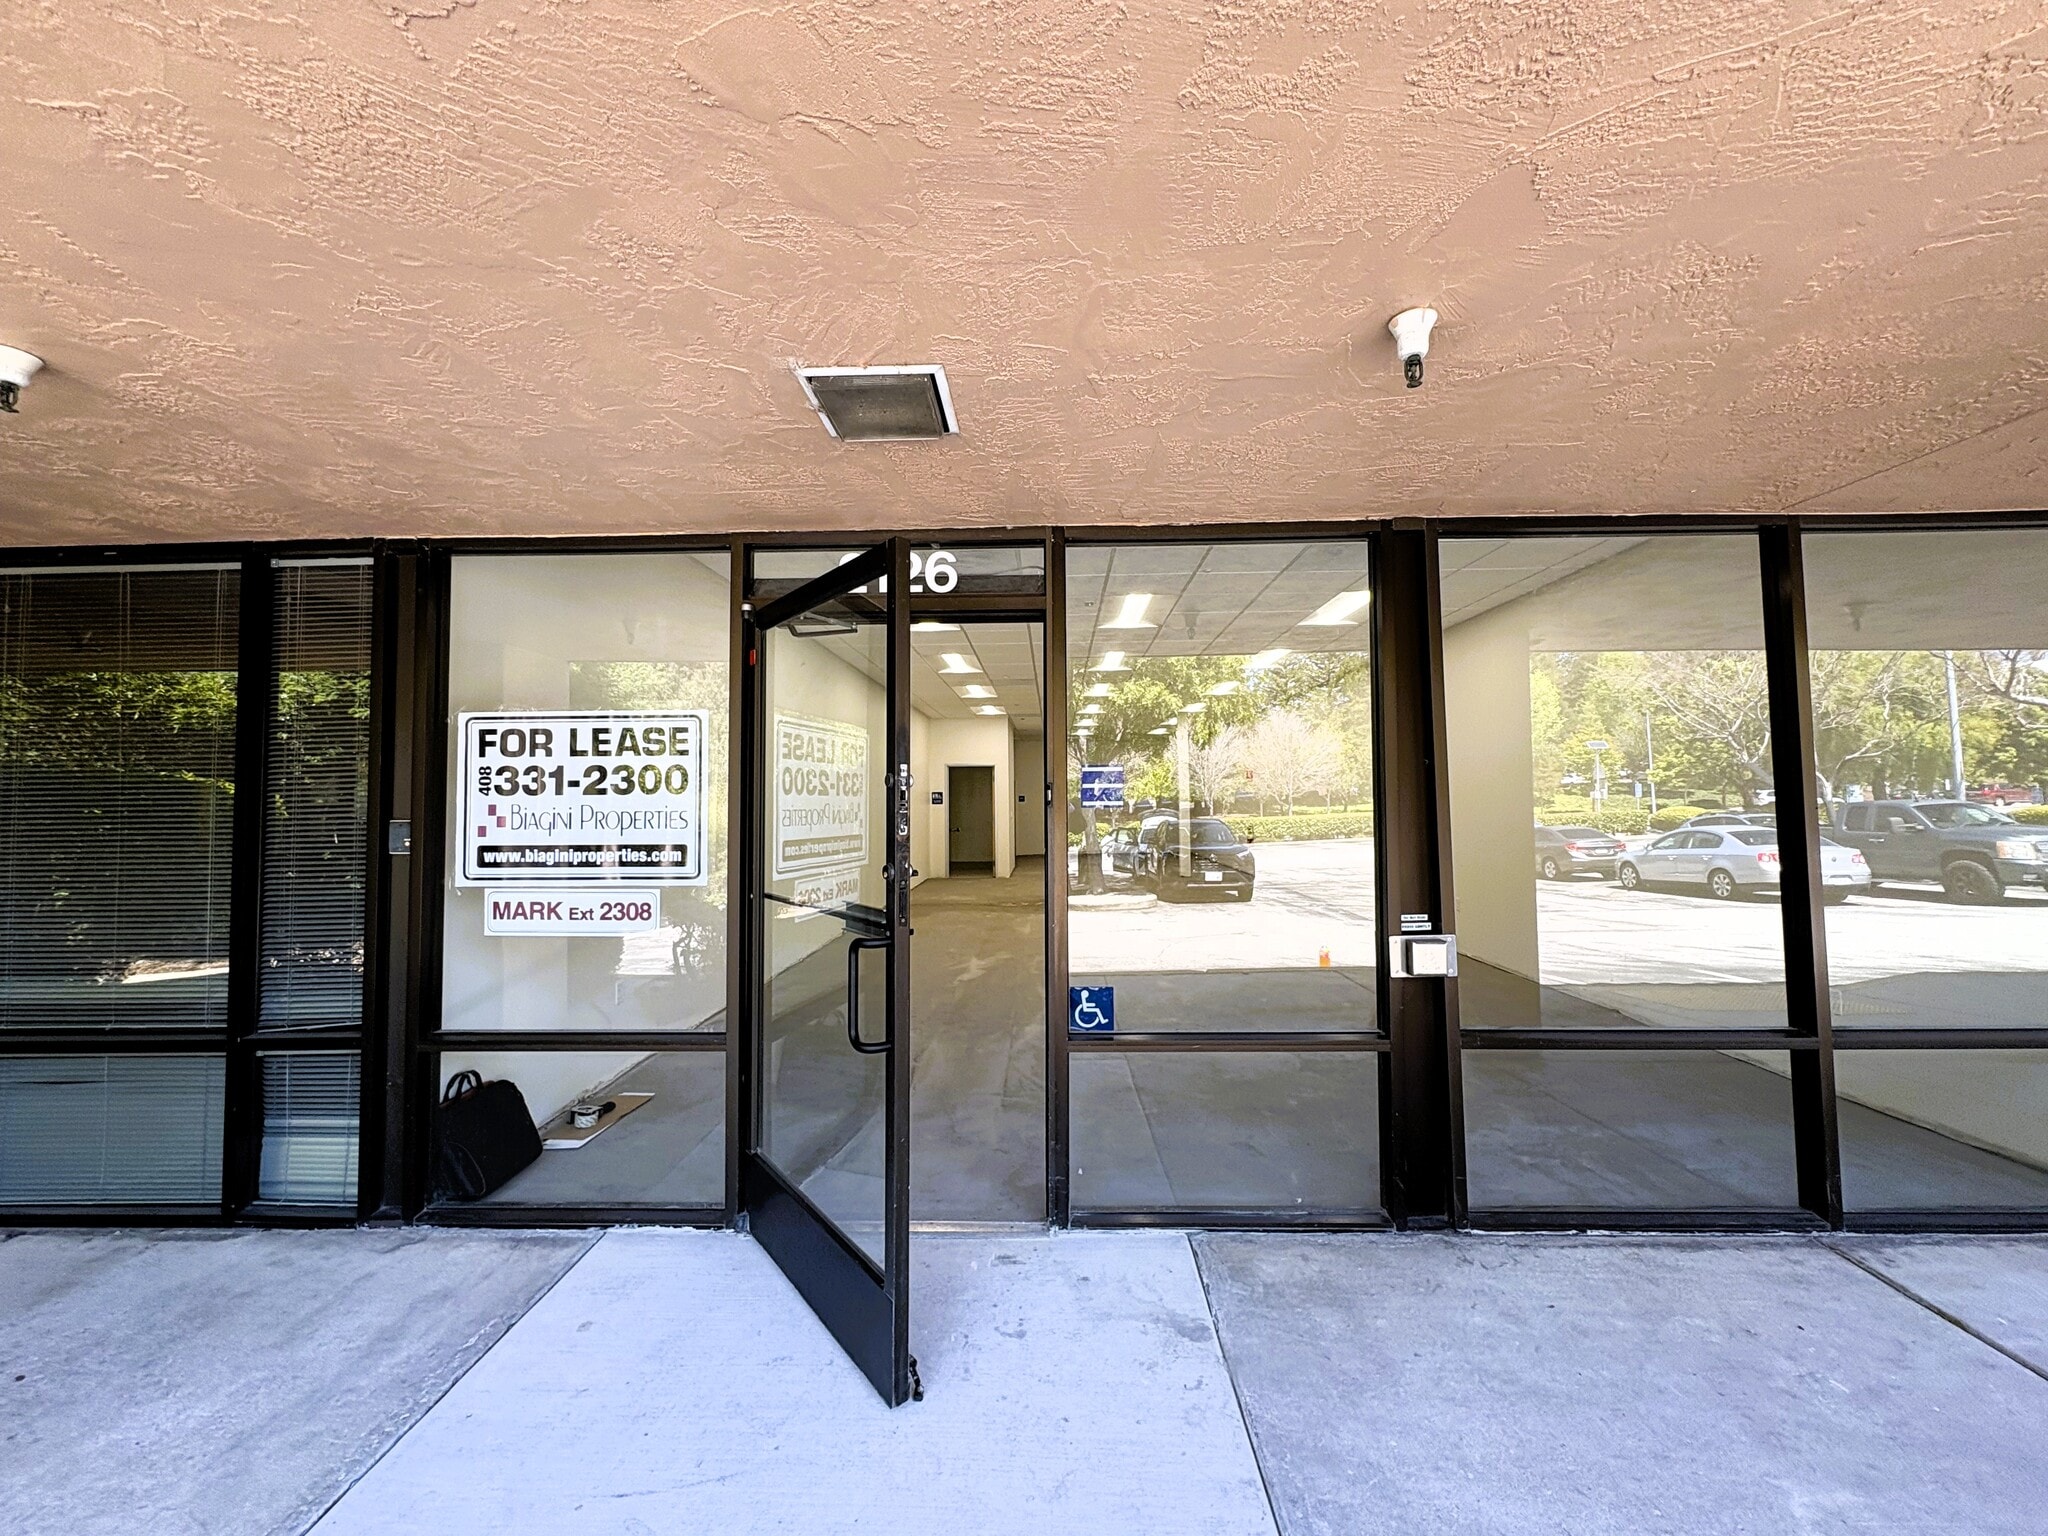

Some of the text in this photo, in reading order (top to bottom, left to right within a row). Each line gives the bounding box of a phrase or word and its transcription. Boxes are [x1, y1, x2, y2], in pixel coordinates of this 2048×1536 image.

[478, 727, 690, 758] FOR LEASE
[478, 765, 493, 797] 408
[493, 763, 689, 797] 331-2300
[483, 849, 682, 866] www.biaginiproperties.com
[492, 901, 652, 921] MARK Ext 2308
